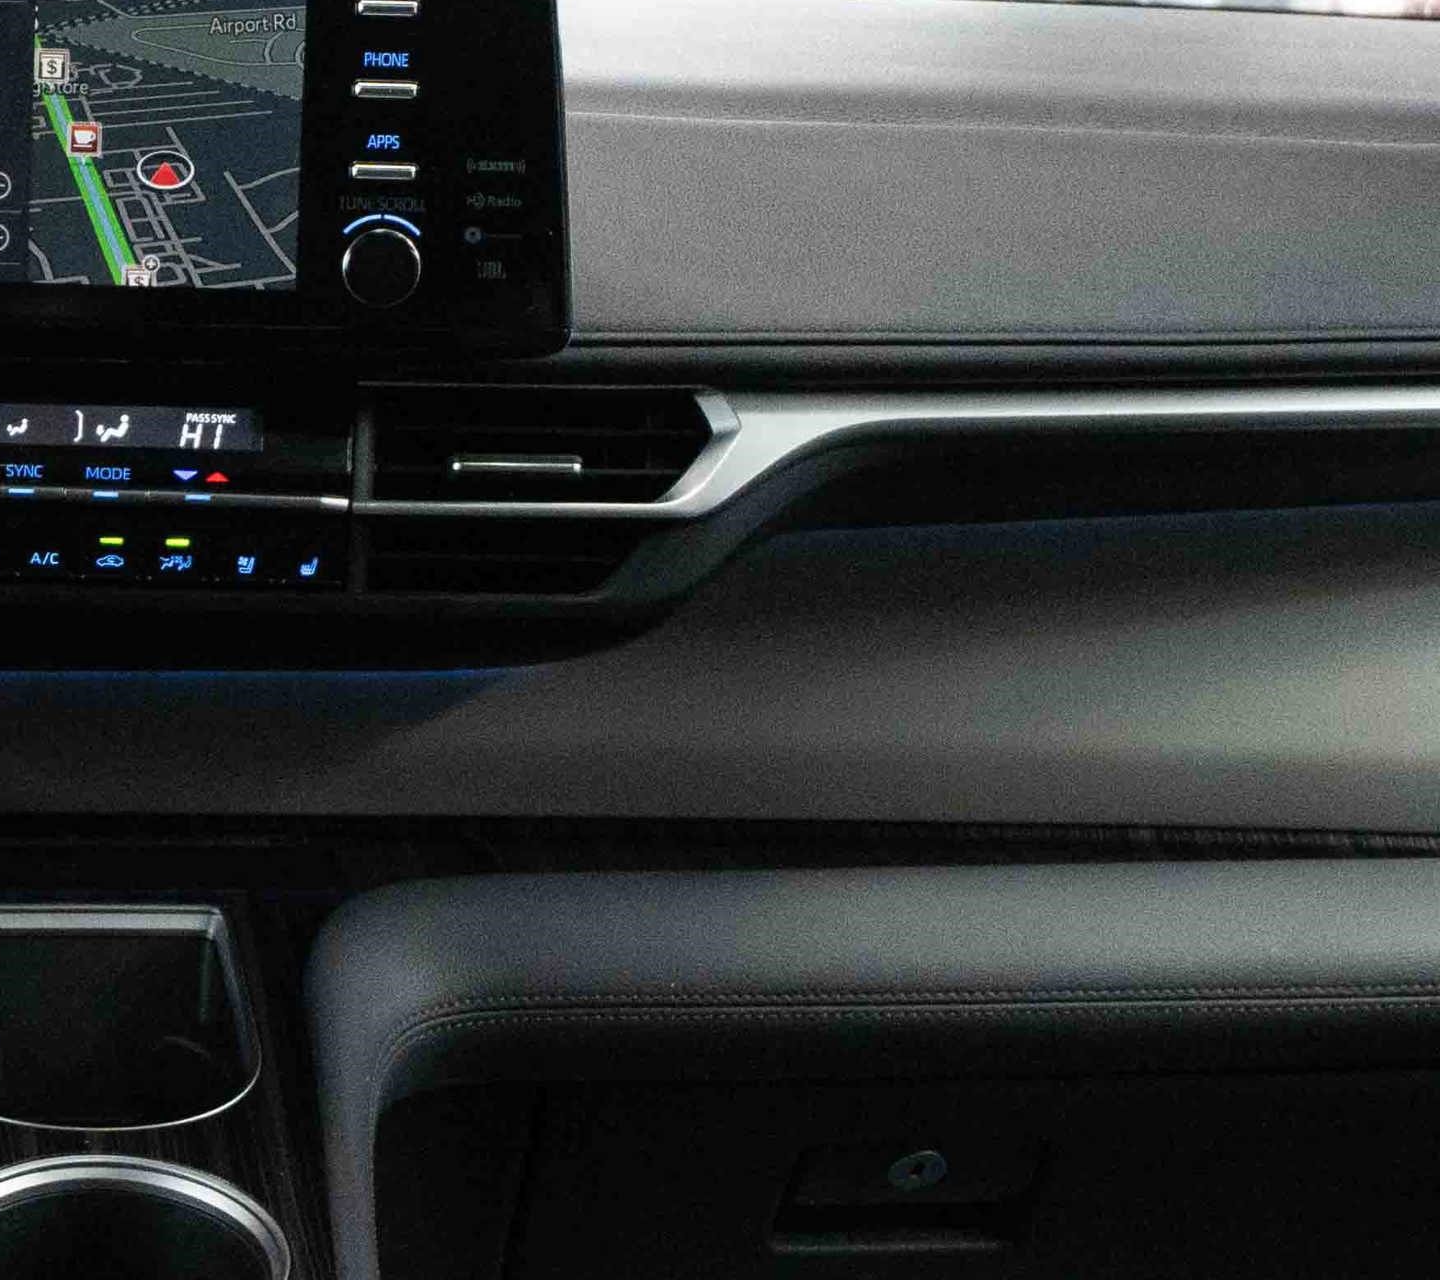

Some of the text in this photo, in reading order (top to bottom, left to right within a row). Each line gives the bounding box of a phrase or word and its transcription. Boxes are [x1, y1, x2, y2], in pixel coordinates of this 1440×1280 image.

[209, 13, 297, 36] Airport Rd
[363, 52, 409, 68] PHONE
[366, 134, 401, 150] APPS
[186, 413, 210, 424] PASS
[5, 463, 44, 479] SYNC
[85, 466, 132, 481] MODE
[30, 552, 60, 566] A/C
